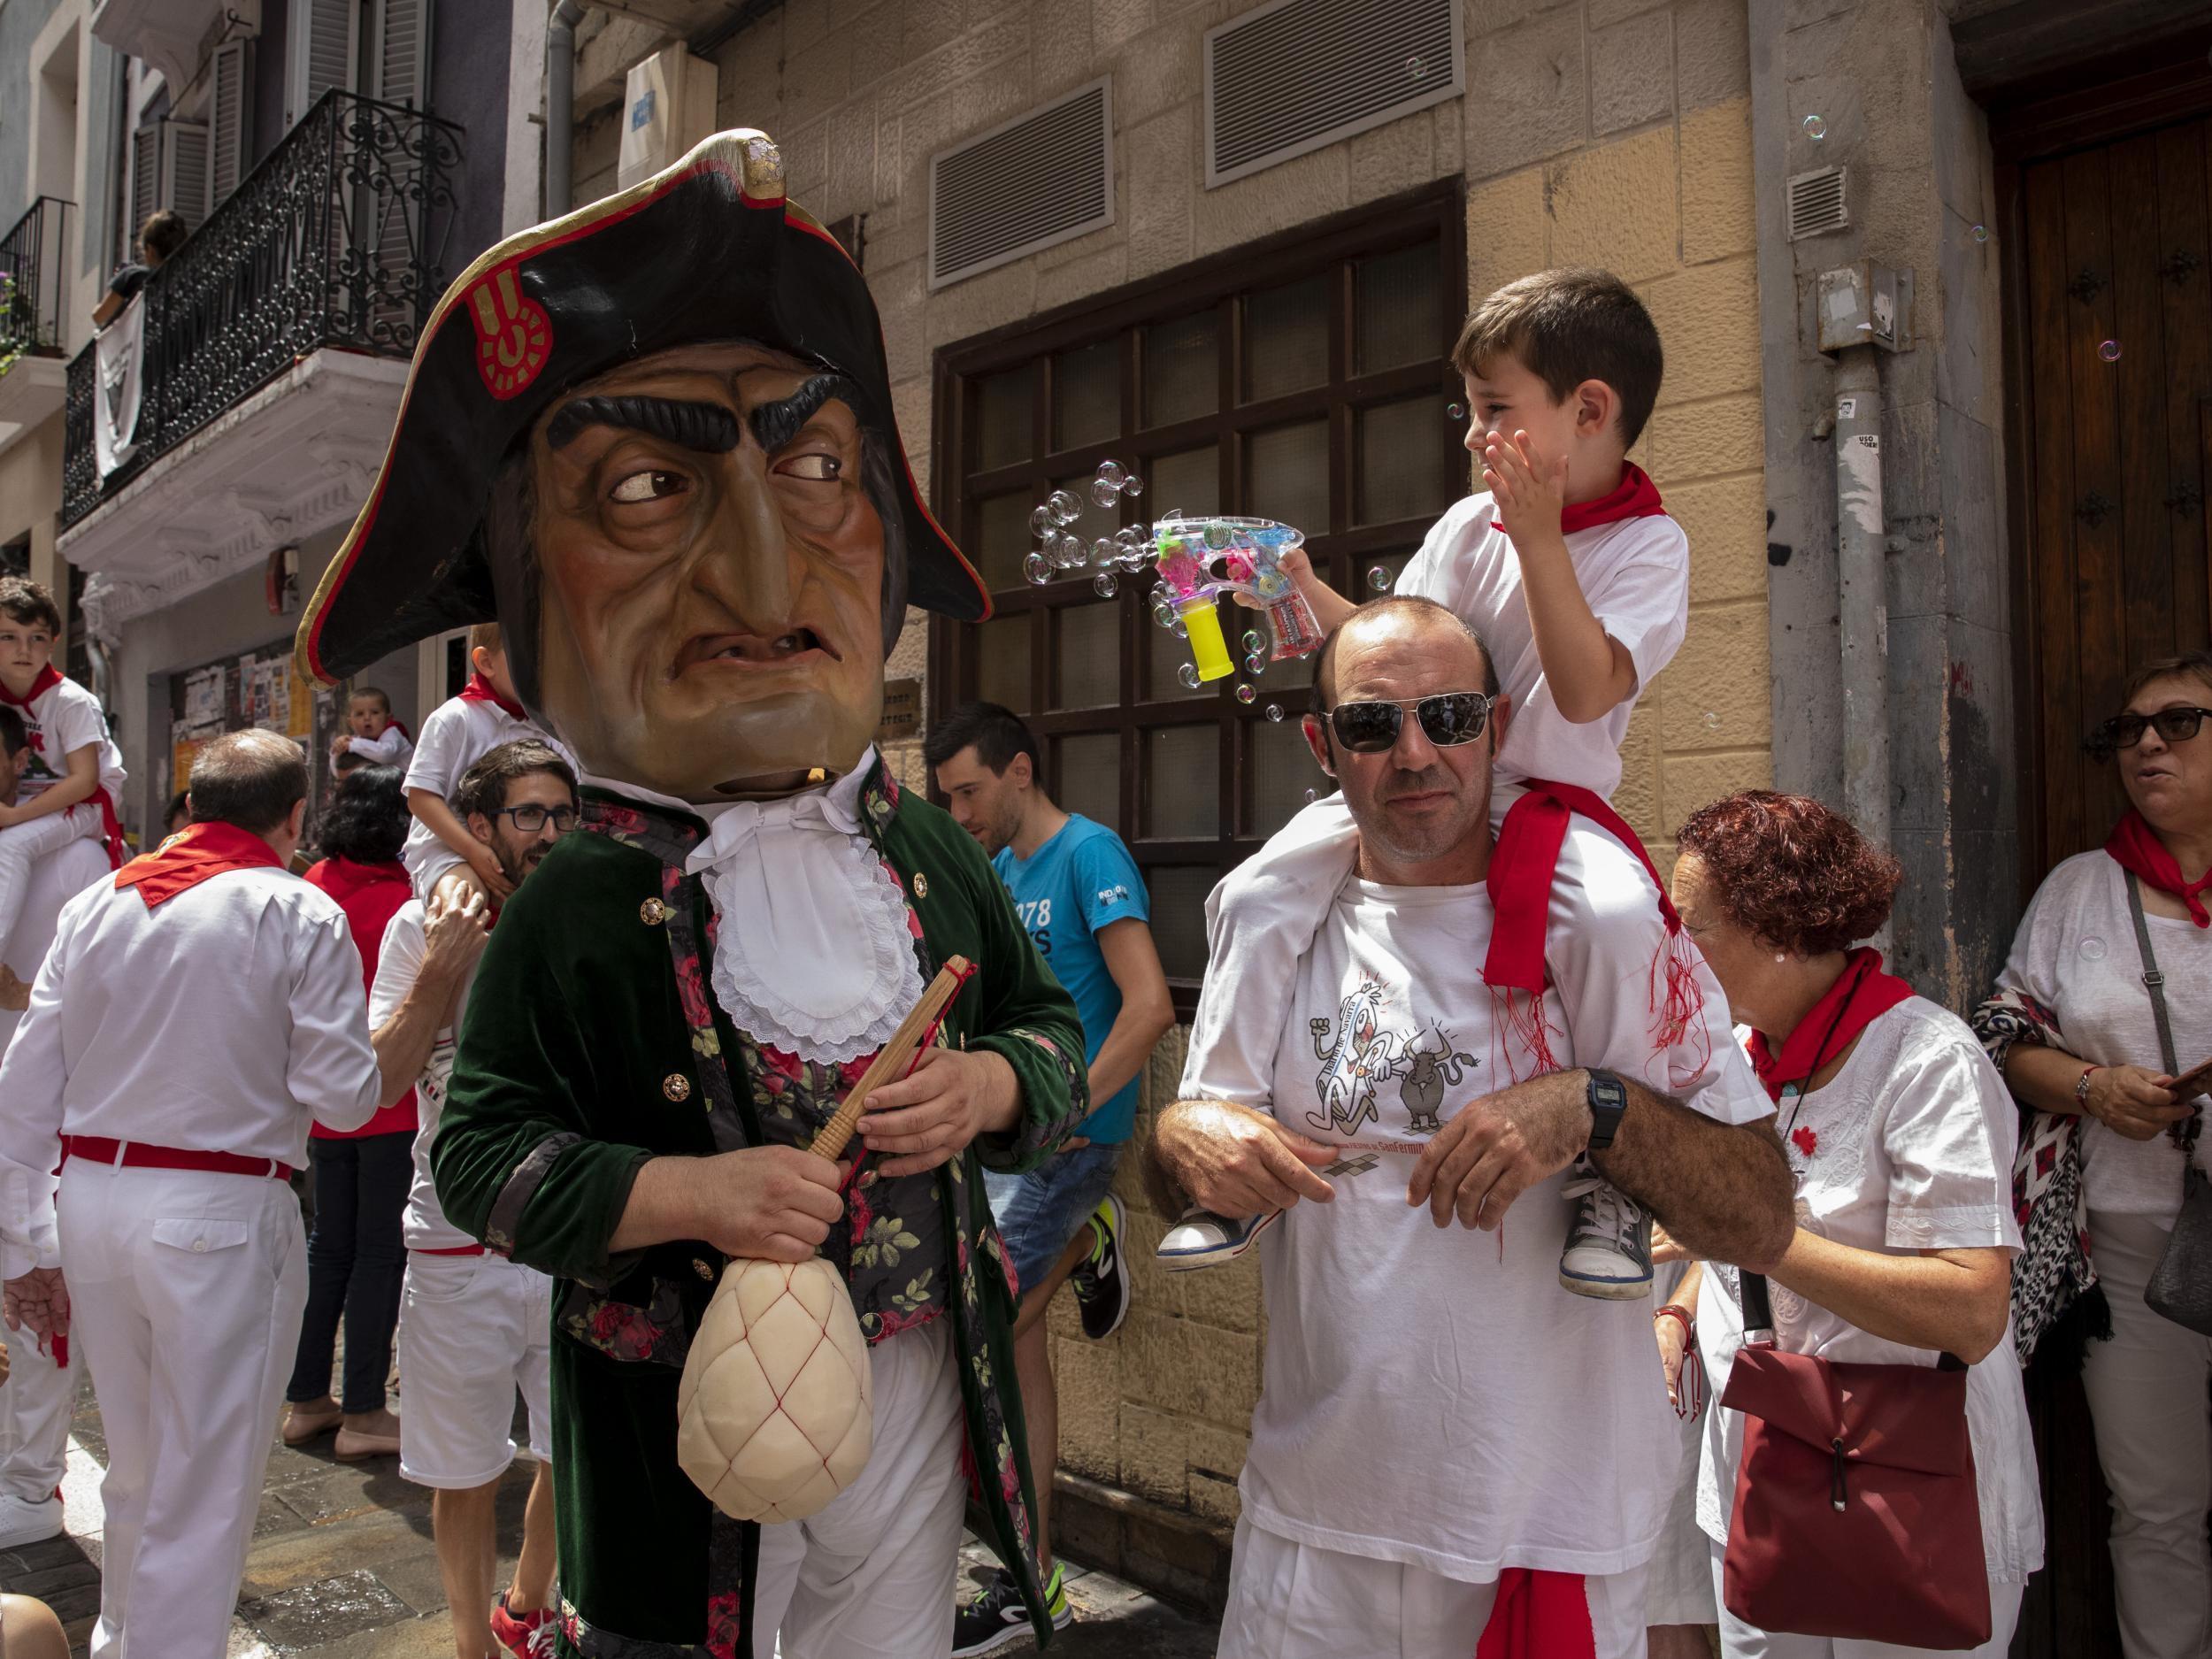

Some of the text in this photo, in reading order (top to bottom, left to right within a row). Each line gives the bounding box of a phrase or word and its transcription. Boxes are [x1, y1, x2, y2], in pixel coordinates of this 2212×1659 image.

[1323, 1001, 1356, 1076] Diario de Navarra
